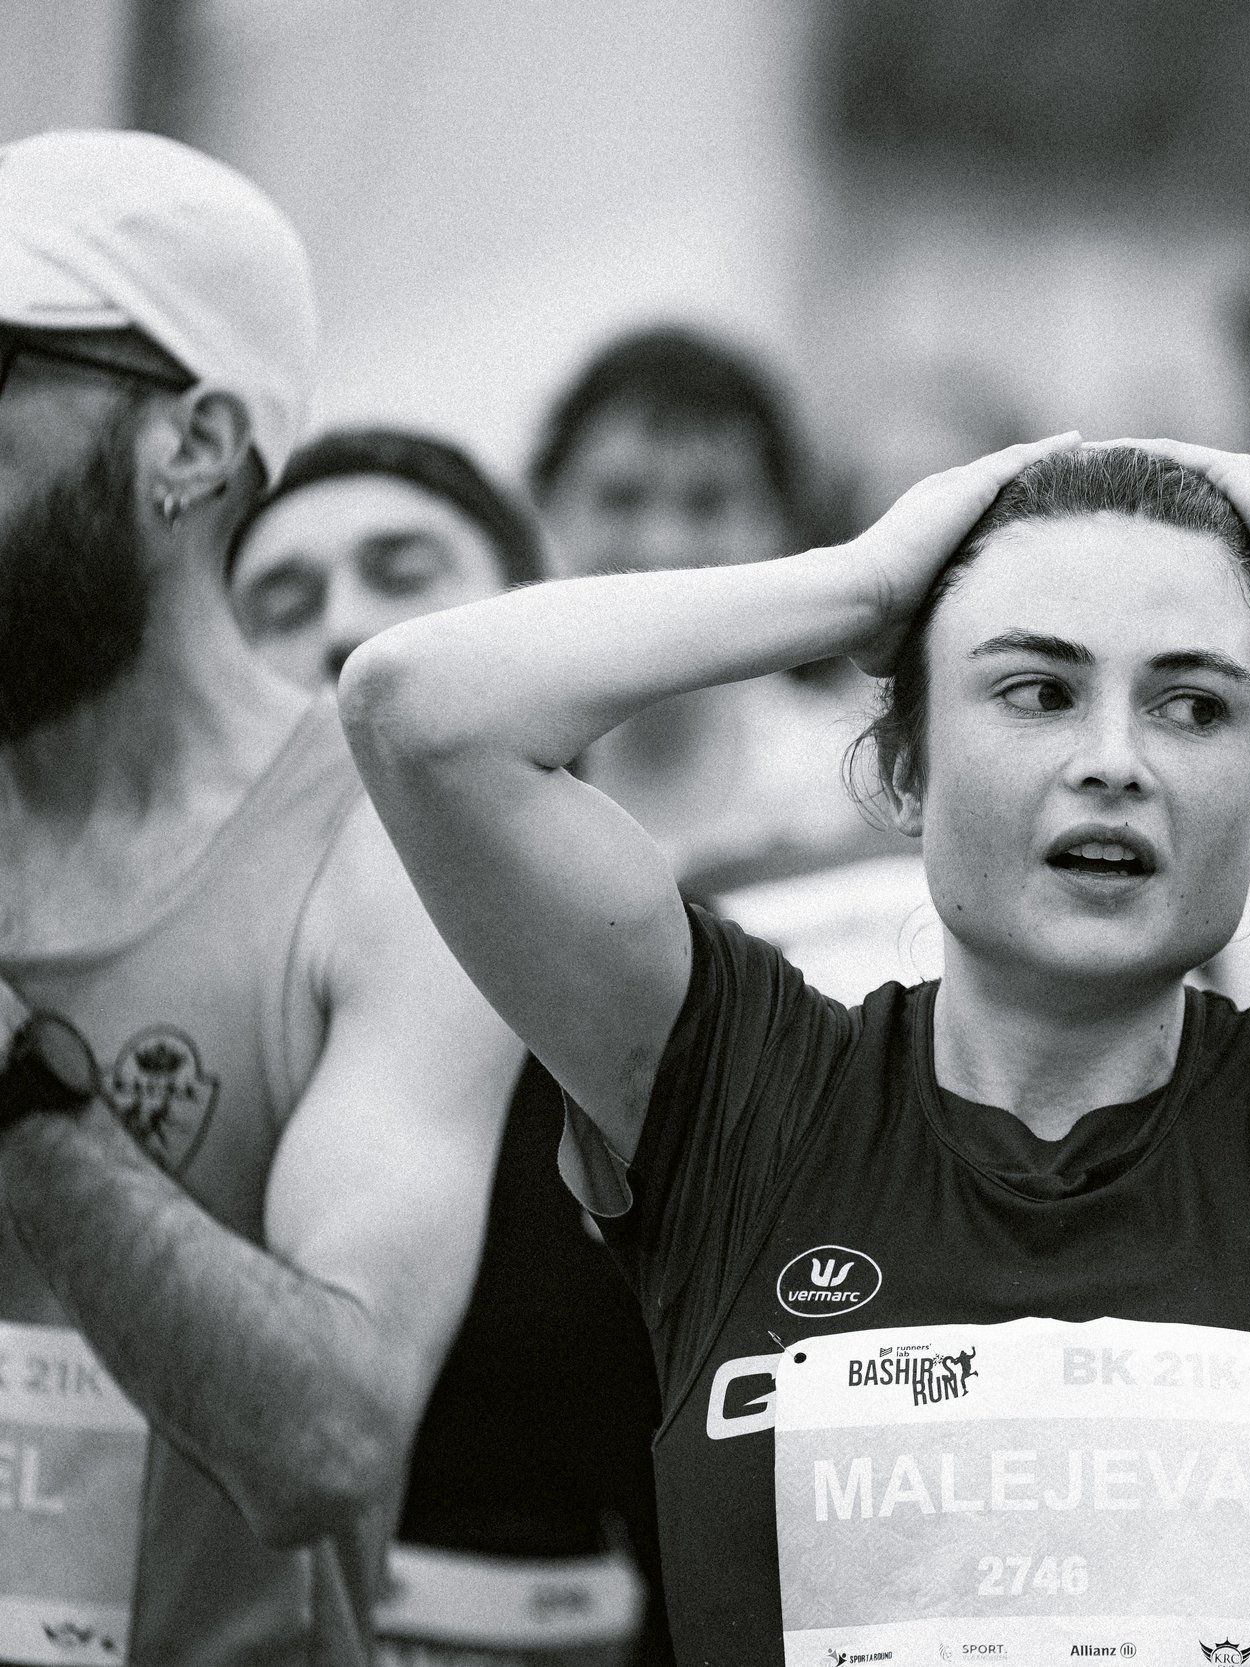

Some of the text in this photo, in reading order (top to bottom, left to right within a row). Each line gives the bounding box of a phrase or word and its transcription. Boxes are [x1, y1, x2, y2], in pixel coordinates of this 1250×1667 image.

[788, 1290, 861, 1302] vermarc
[896, 1343, 932, 1351] runners'
[1063, 1347, 1240, 1390] BK 21K
[912, 1374, 959, 1407] RUN
[977, 1554, 1090, 1597] 2746
[1070, 1644, 1117, 1656] Allianz
[1214, 1653, 1240, 1665] KRC
